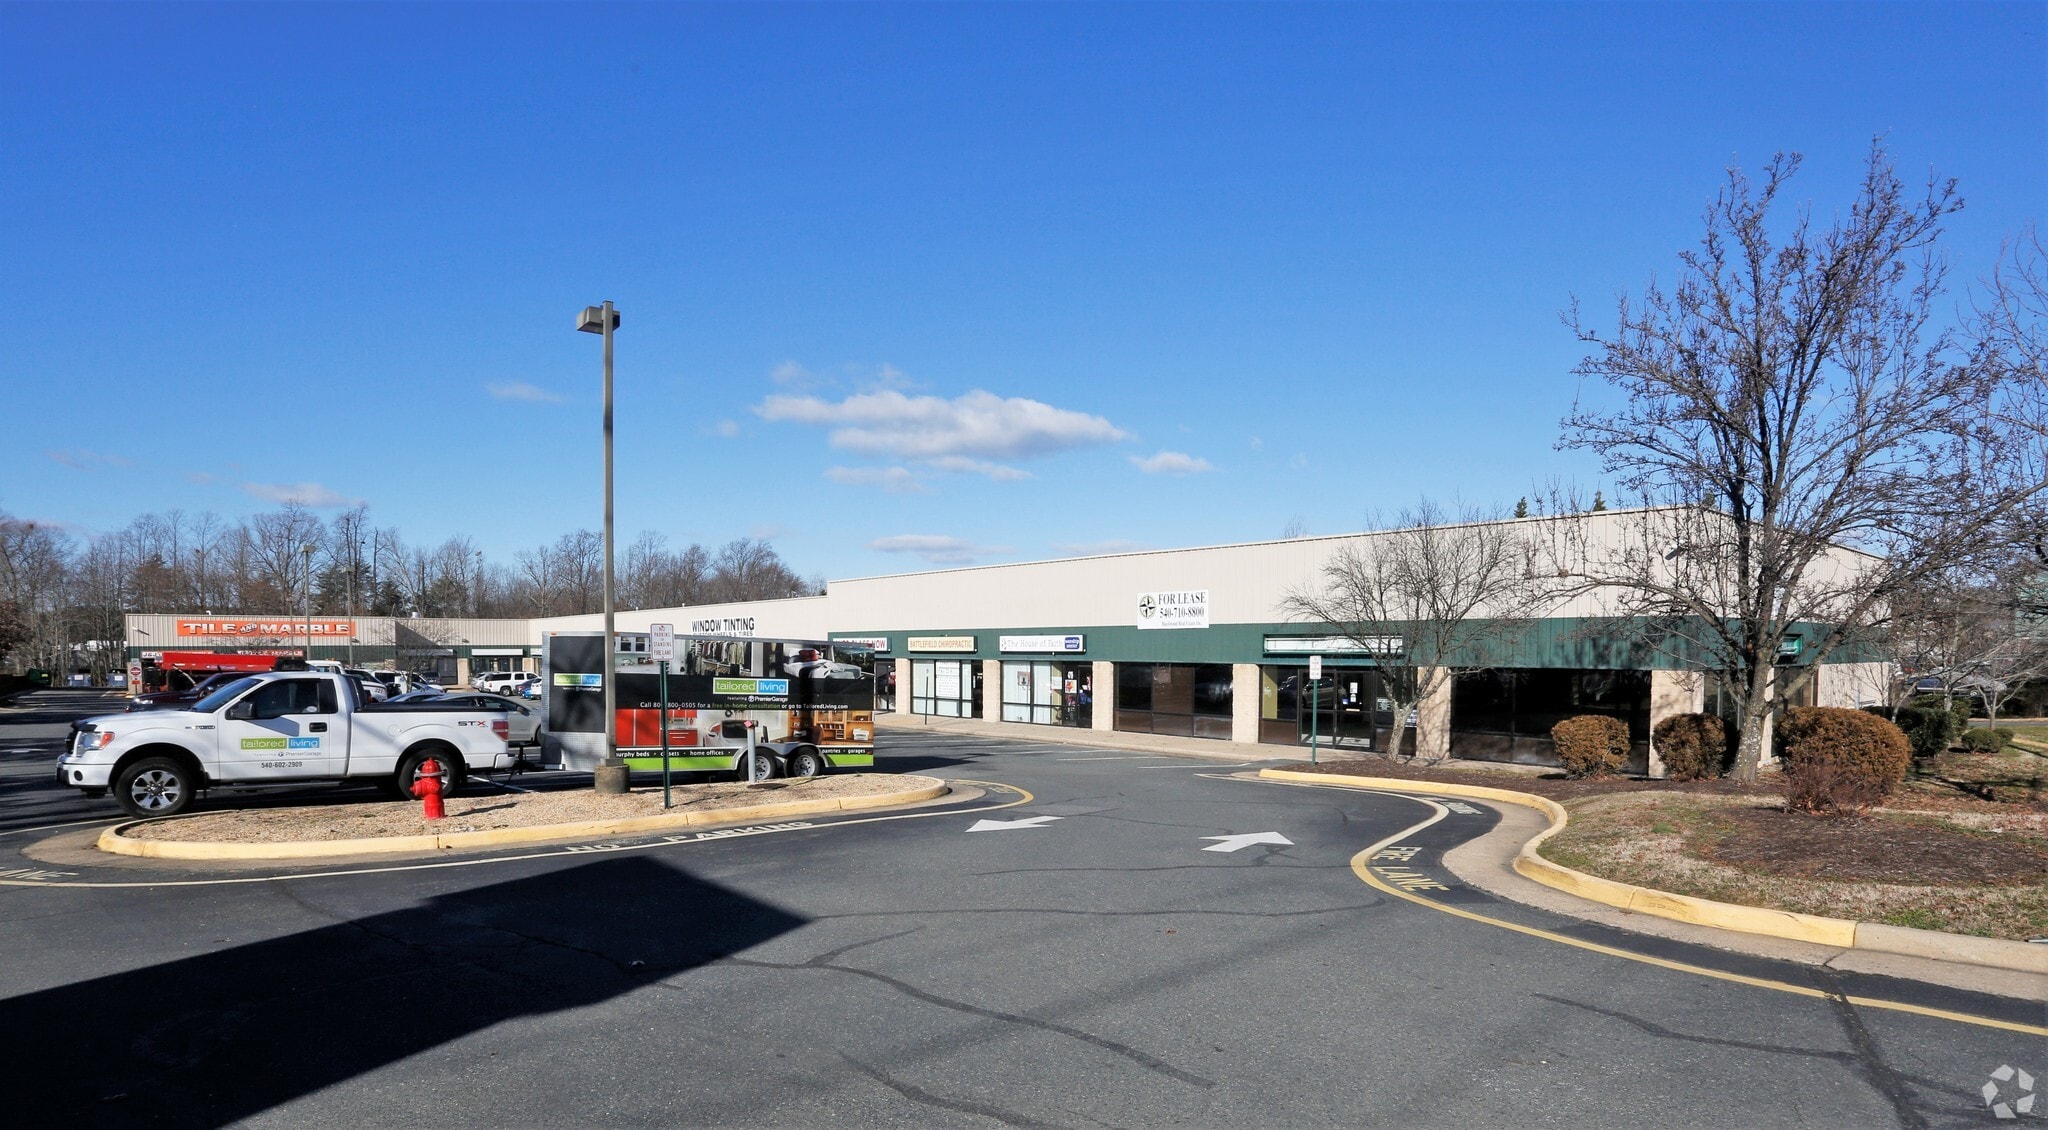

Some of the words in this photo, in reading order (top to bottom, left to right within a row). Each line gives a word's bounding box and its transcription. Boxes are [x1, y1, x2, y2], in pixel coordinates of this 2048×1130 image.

[1158, 593, 1176, 605] FOR
[1177, 591, 1207, 604] LEASE
[1159, 606, 1205, 618] 540-710-8800
[183, 622, 236, 635] TILE
[239, 622, 258, 634] AND
[259, 623, 350, 636] MARBLE
[691, 619, 722, 633] WINDOW
[723, 616, 755, 631] TINTING
[909, 640, 937, 648] BATTLEFIELD
[937, 639, 973, 648] CHIROPRACTIC
[1007, 639, 1019, 648] The
[1020, 639, 1036, 648] House
[1047, 639, 1064, 648] Faith
[716, 680, 756, 691] tailored
[760, 680, 786, 692] living
[754, 695, 788, 703] PremierGarage
[242, 738, 286, 748] tailored
[290, 738, 319, 749] living
[567, 844, 621, 853] NO
[662, 821, 813, 843] PARKING
[1370, 846, 1423, 861] FIRE
[1371, 866, 1451, 891] LANE
